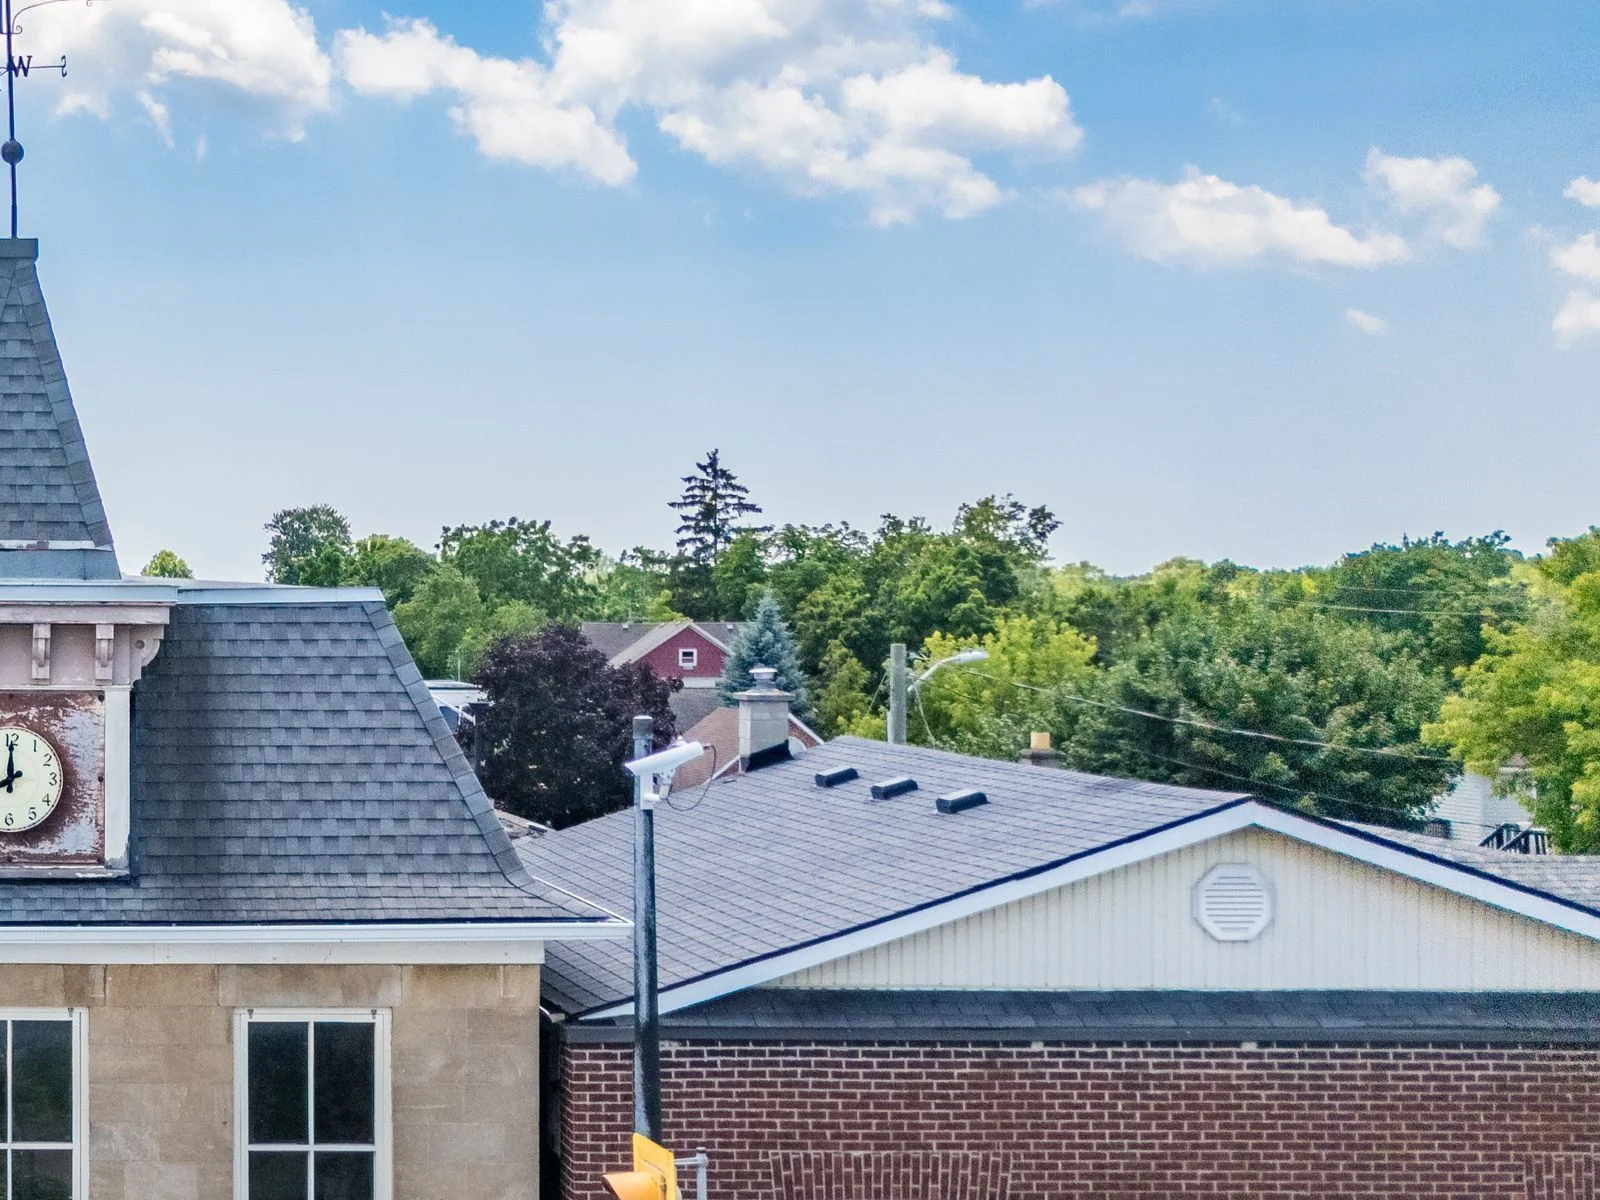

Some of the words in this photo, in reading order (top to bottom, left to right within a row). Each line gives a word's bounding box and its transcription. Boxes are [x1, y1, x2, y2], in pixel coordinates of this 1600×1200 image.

[5, 733, 19, 747] 12
[33, 739, 38, 752] 1
[43, 752, 52, 767] 2
[49, 771, 58, 786] 3
[42, 793, 51, 807] 4
[4, 813, 14, 827] 6
[28, 807, 38, 821] 5
